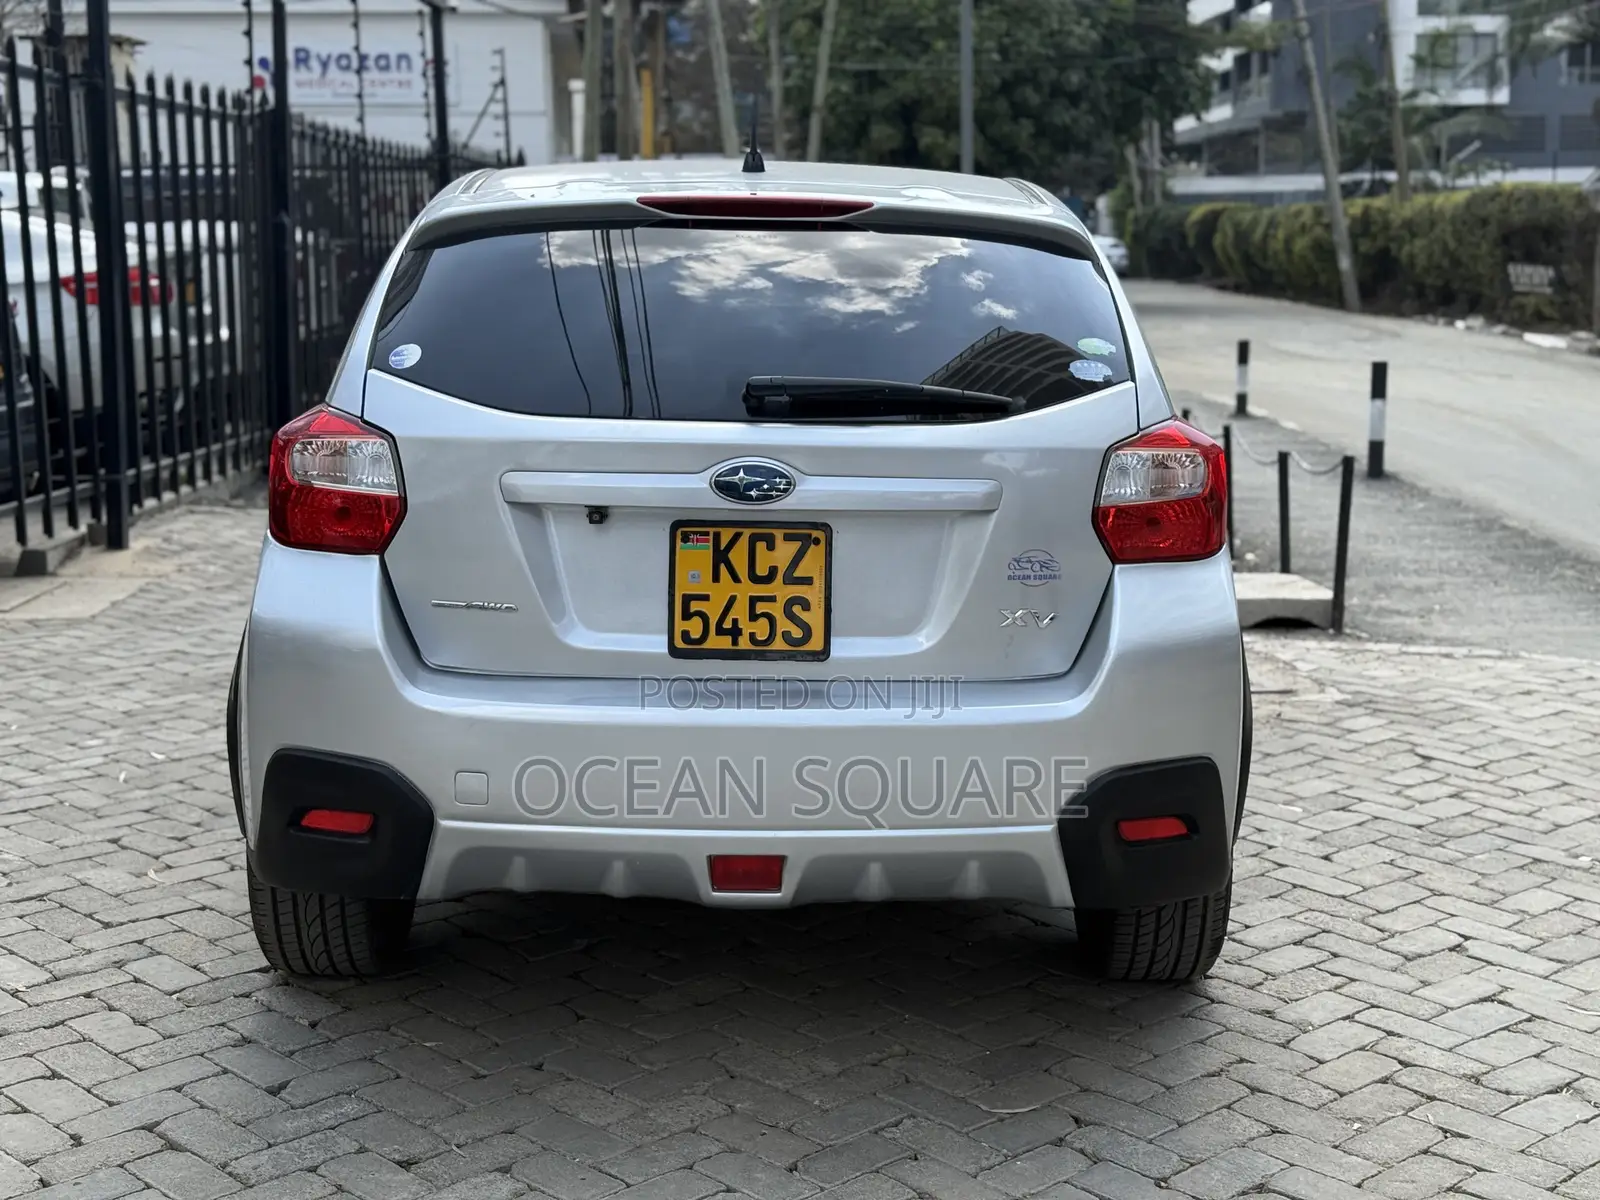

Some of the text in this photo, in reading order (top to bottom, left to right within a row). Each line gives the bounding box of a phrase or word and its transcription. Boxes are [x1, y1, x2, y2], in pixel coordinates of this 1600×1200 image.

[294, 47, 413, 78] Ryazan
[711, 531, 814, 585] KCZ
[680, 593, 813, 647] 545S
[1000, 608, 1059, 628] XV
